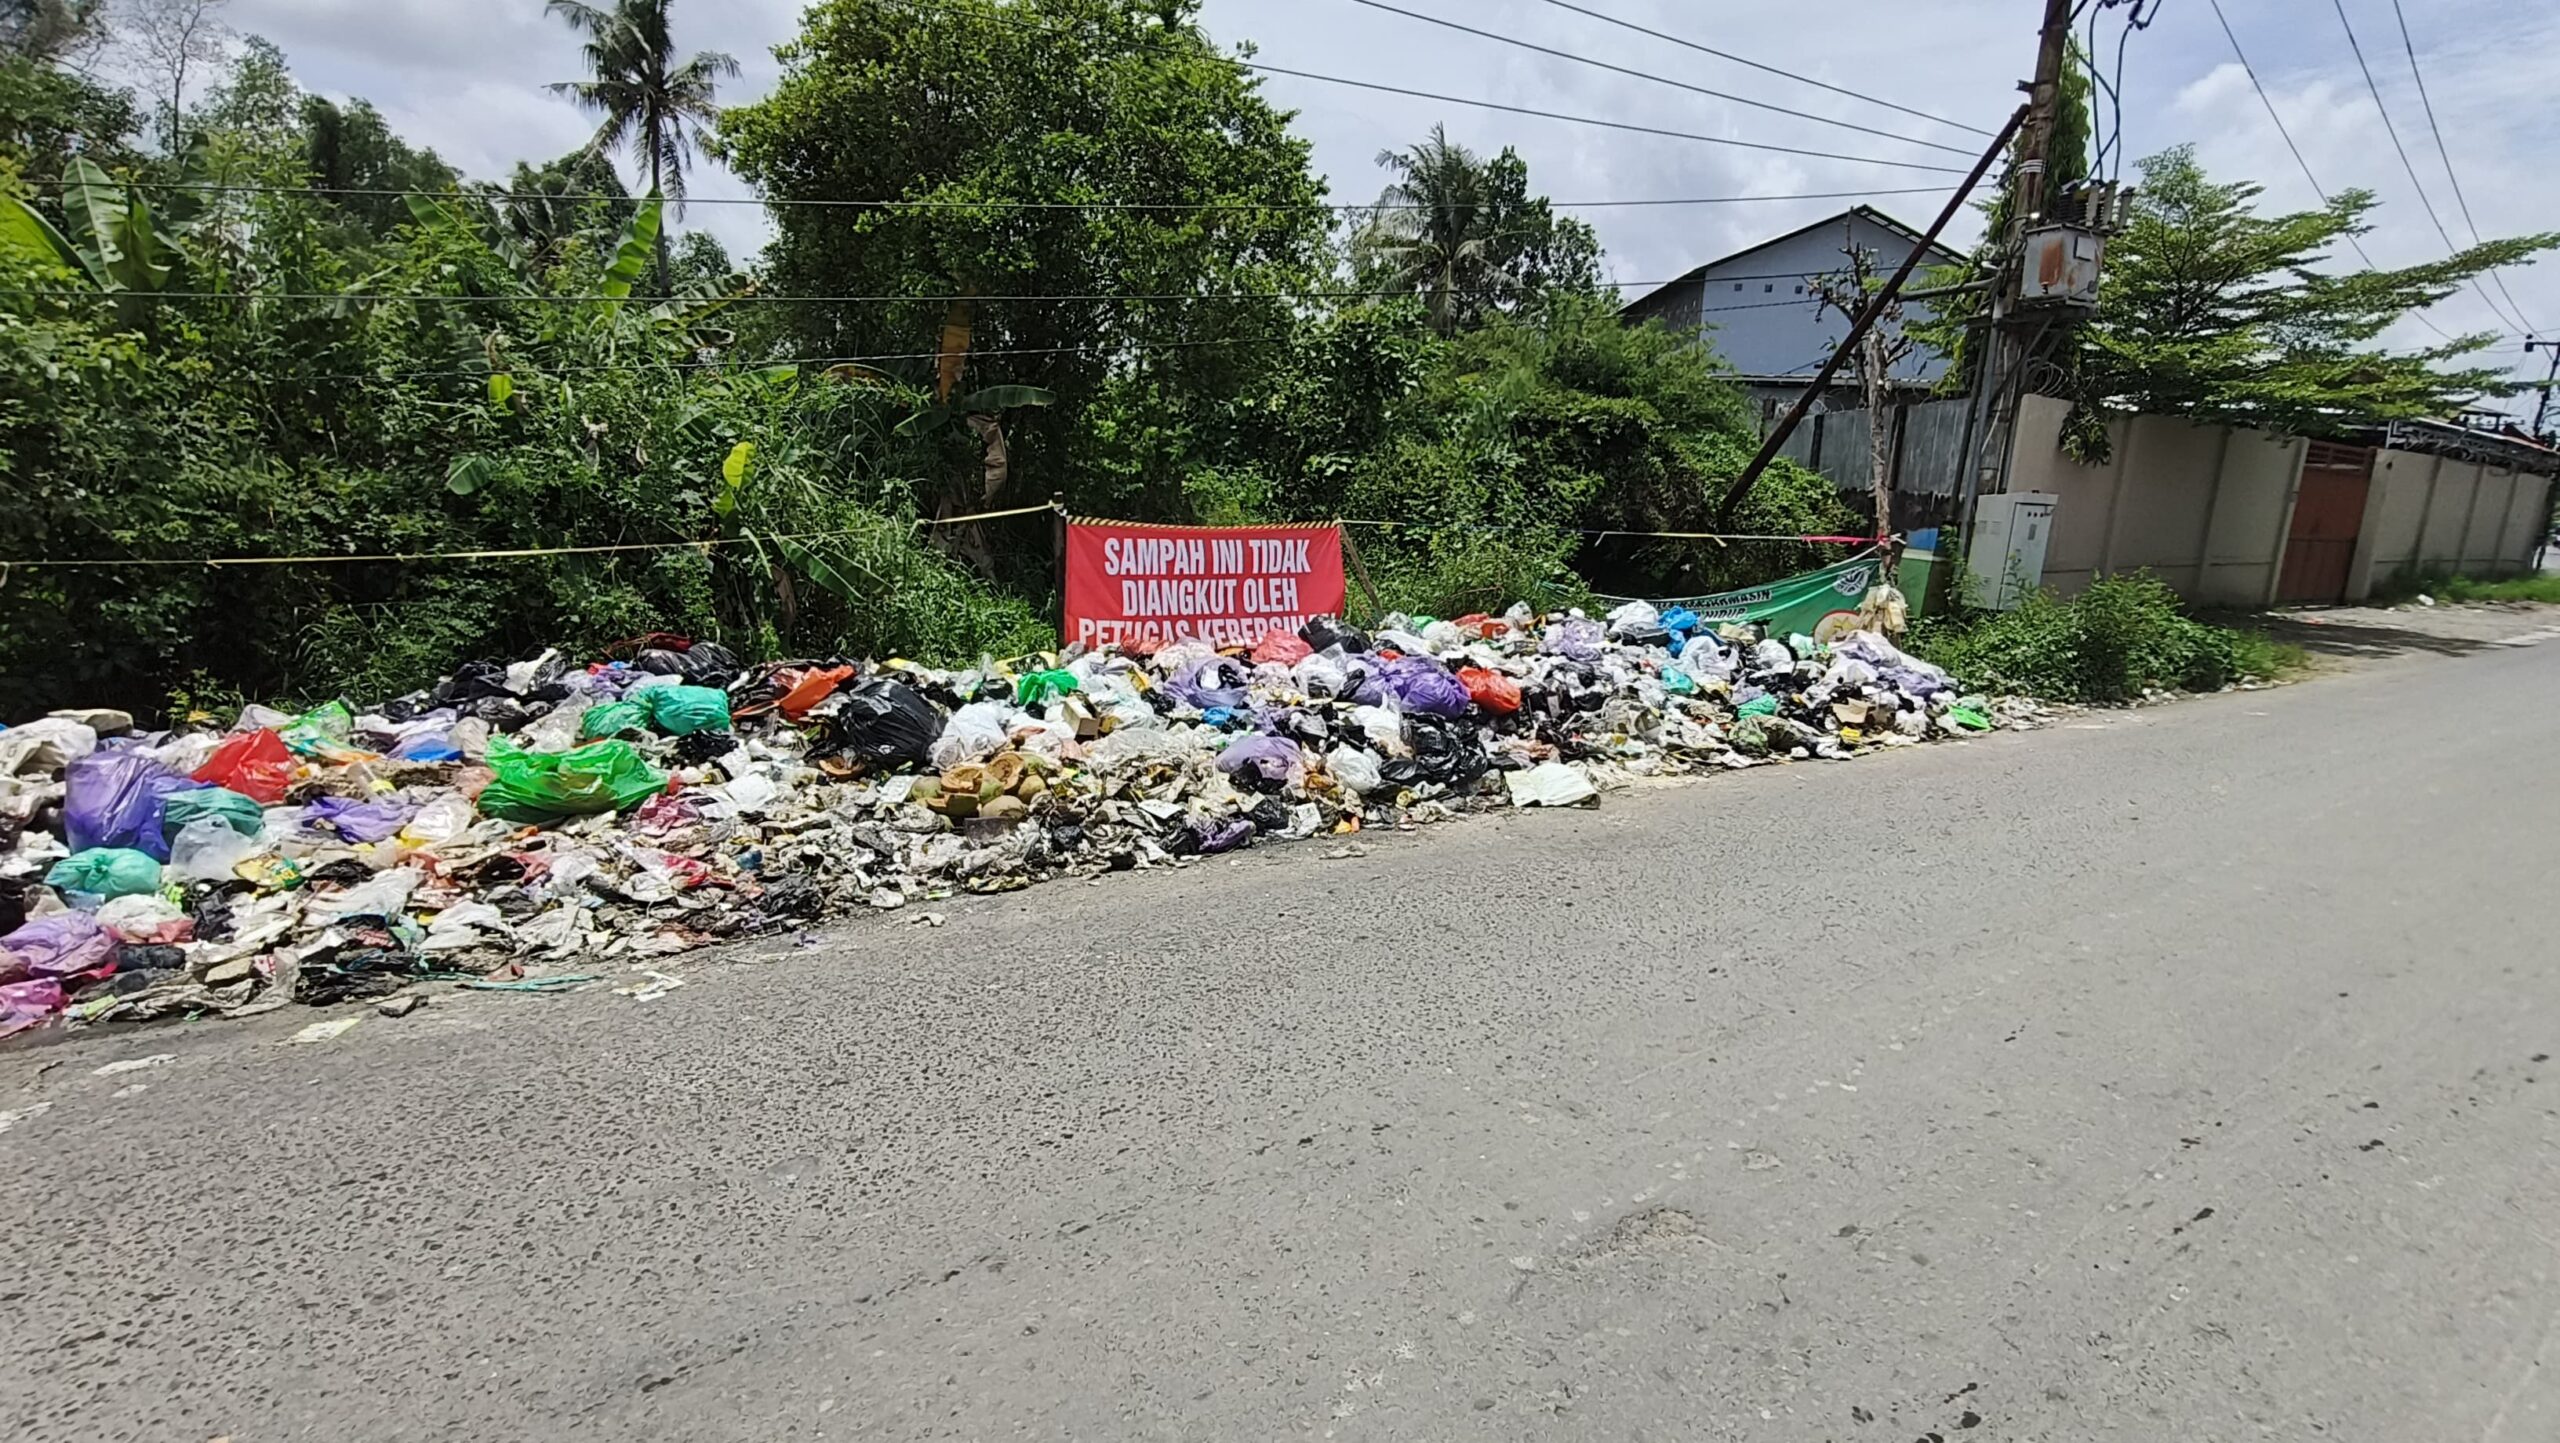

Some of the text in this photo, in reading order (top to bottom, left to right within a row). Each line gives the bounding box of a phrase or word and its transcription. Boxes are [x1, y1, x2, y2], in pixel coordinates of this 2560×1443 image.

[1104, 537, 1312, 576] SAMPAH INI TIDAK
[1122, 578, 1299, 617] DIANGKUT OLEH
